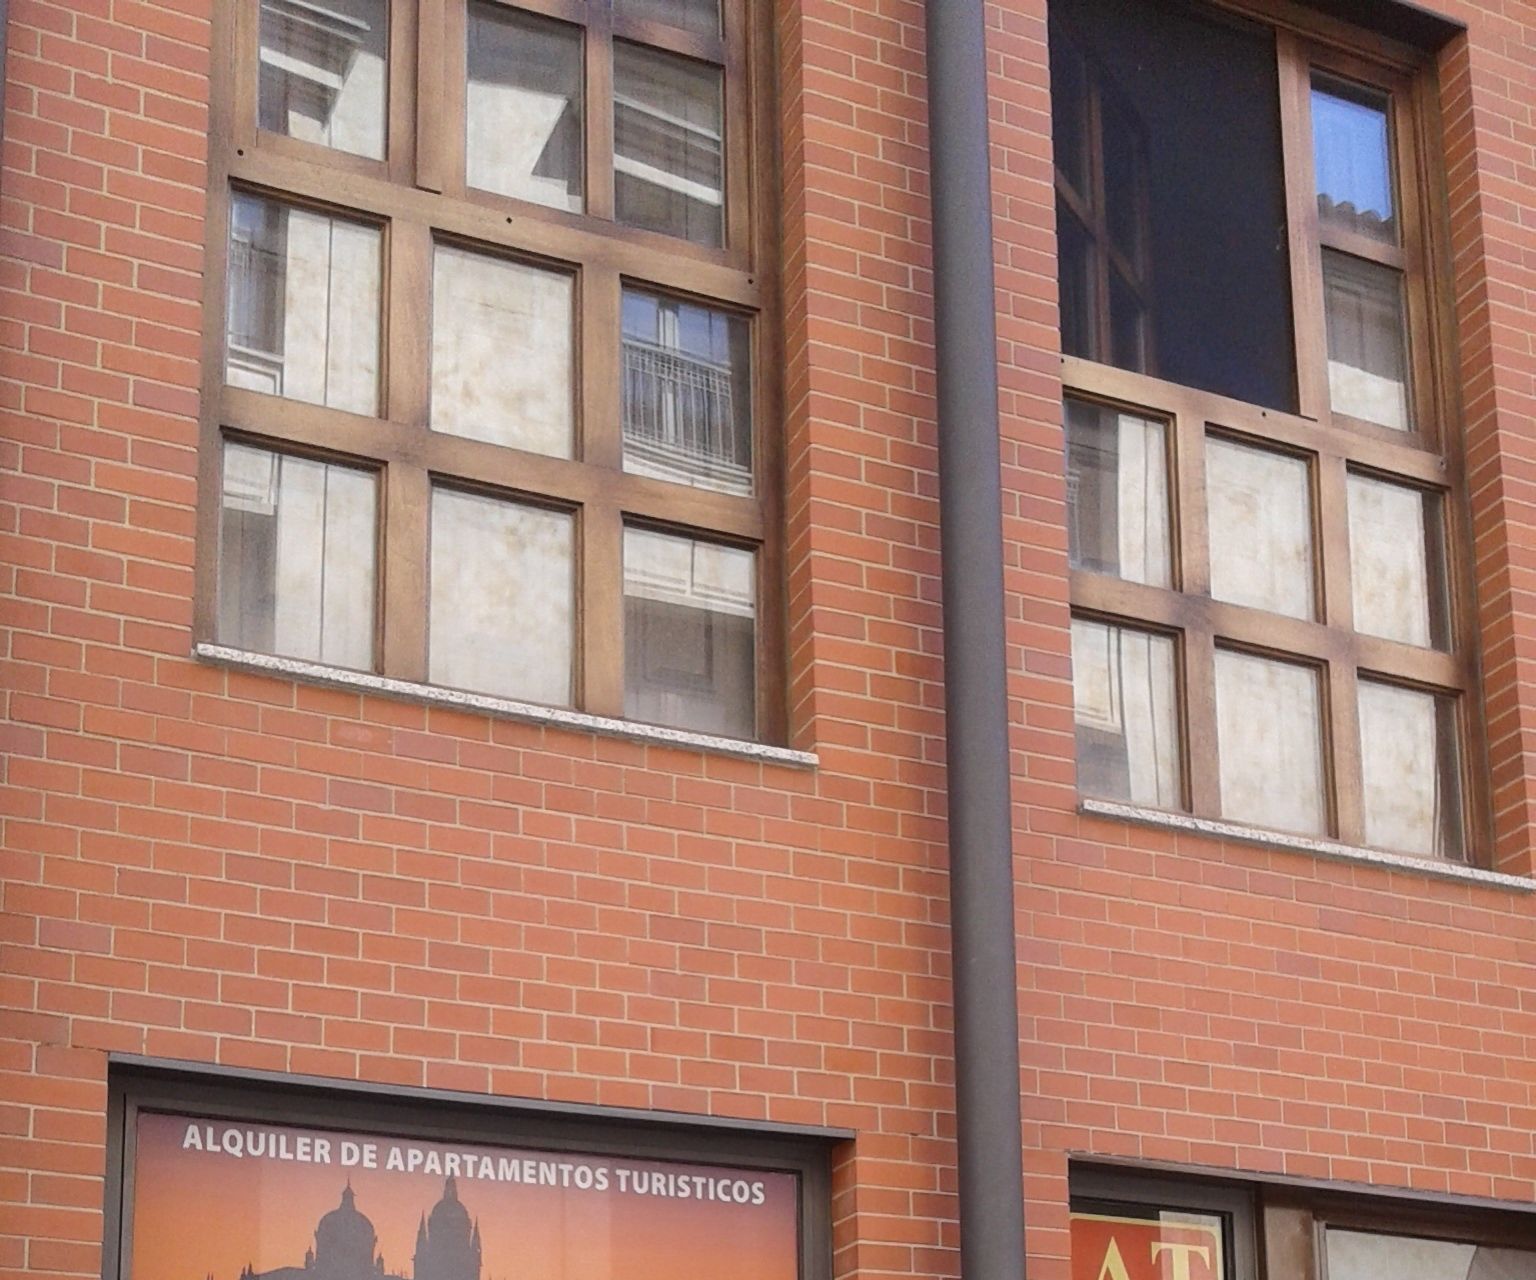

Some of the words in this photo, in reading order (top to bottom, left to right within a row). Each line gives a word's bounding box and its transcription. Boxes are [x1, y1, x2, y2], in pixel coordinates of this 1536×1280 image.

[182, 1125, 331, 1165] ALQUILER
[341, 1142, 377, 1169] DE
[387, 1147, 608, 1192] APARTAMENTOS
[616, 1170, 766, 1205] TURISTICOS
